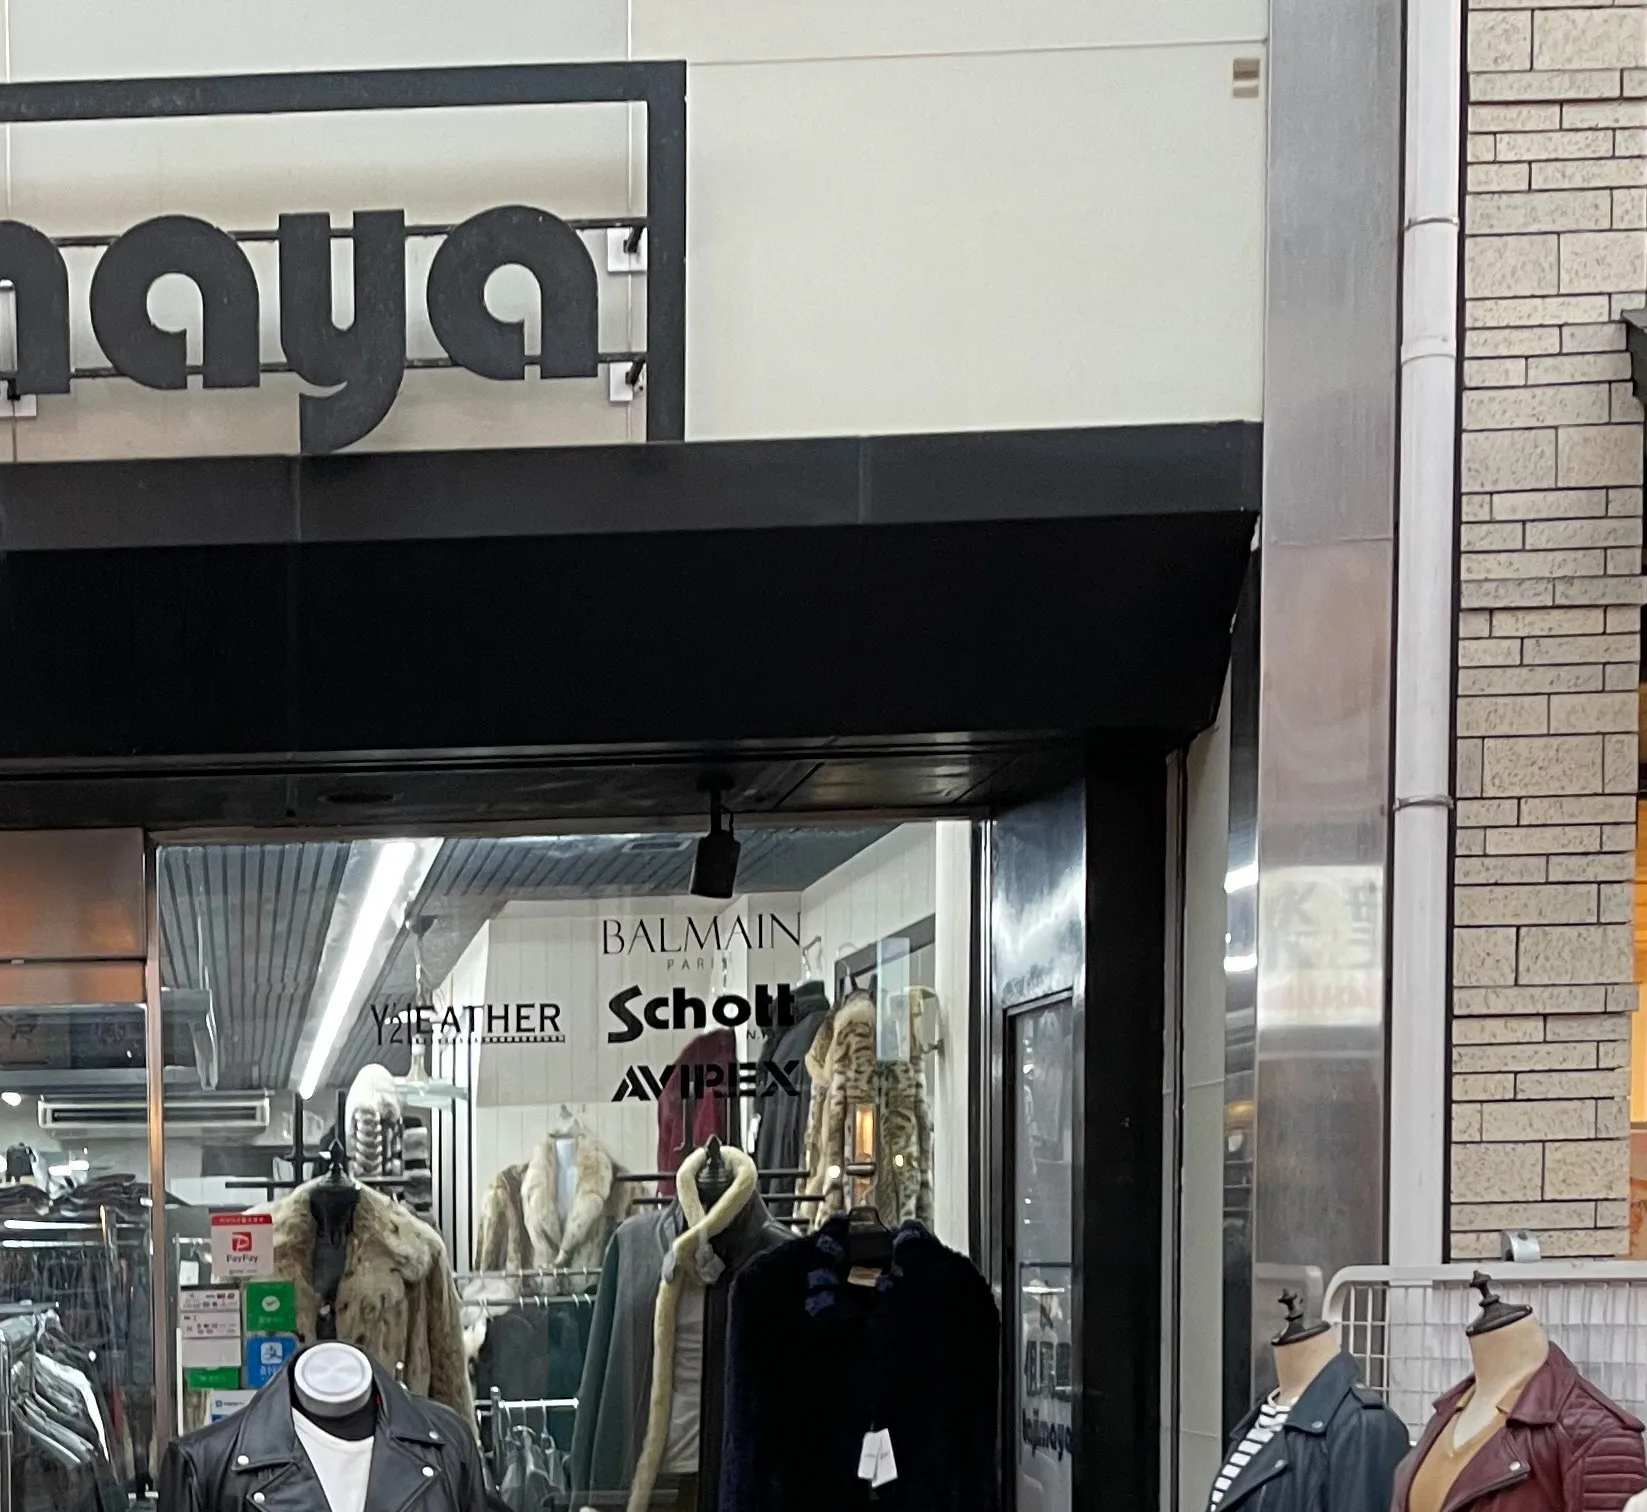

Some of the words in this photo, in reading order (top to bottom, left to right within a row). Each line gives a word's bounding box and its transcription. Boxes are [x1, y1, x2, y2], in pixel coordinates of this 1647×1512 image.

[602, 912, 801, 955] BALMAIN
[608, 983, 795, 1044] Schott
[611, 1060, 801, 1102] AVIREX
